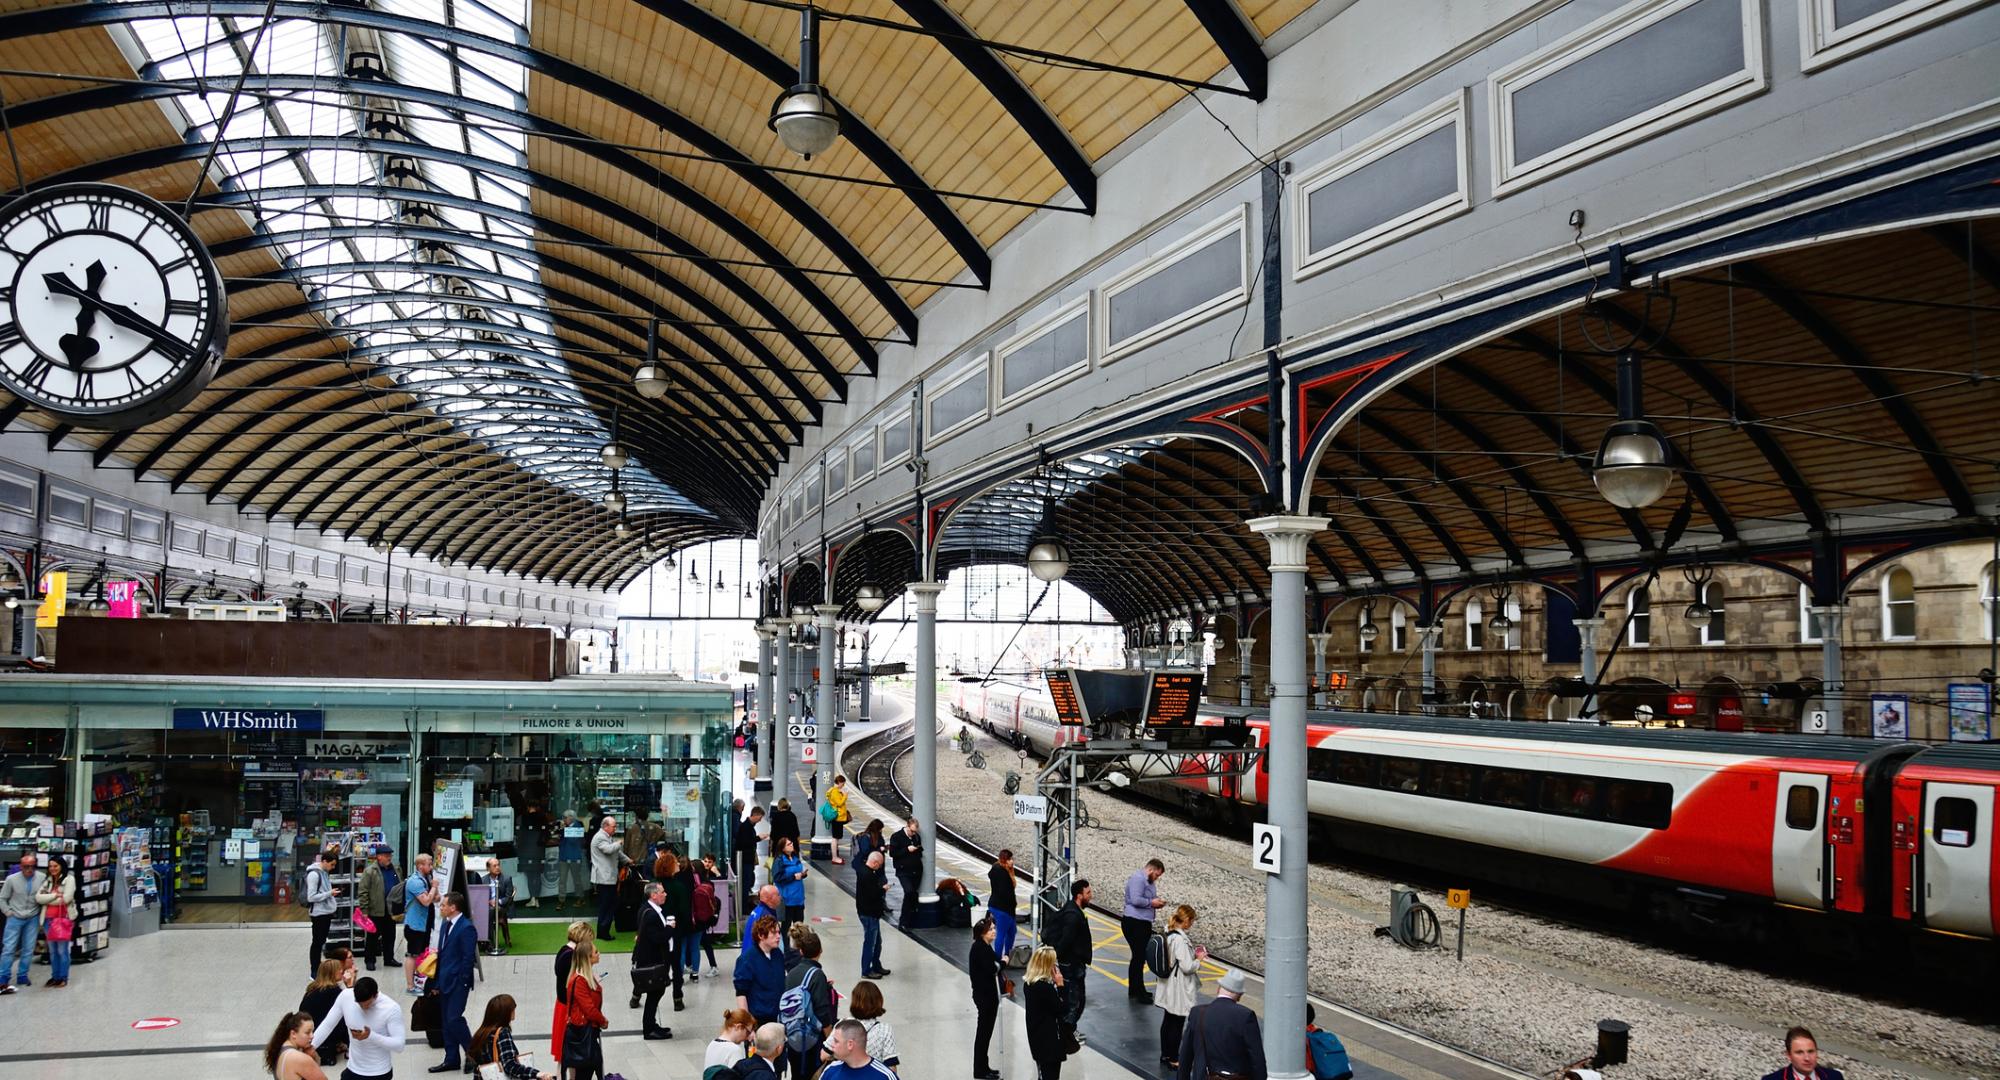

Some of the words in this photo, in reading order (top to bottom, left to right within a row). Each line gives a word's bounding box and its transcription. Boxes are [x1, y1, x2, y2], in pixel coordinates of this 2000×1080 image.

[201, 711, 299, 729] WHSmith
[522, 719, 570, 728] FILMORE
[575, 719, 583, 728] &
[587, 719, 625, 728] UNION
[1814, 713, 1824, 729] 3
[1026, 804, 1042, 814] Platform
[1841, 817, 1848, 826] F
[1896, 822, 1904, 832] H
[1259, 831, 1274, 866] 2
